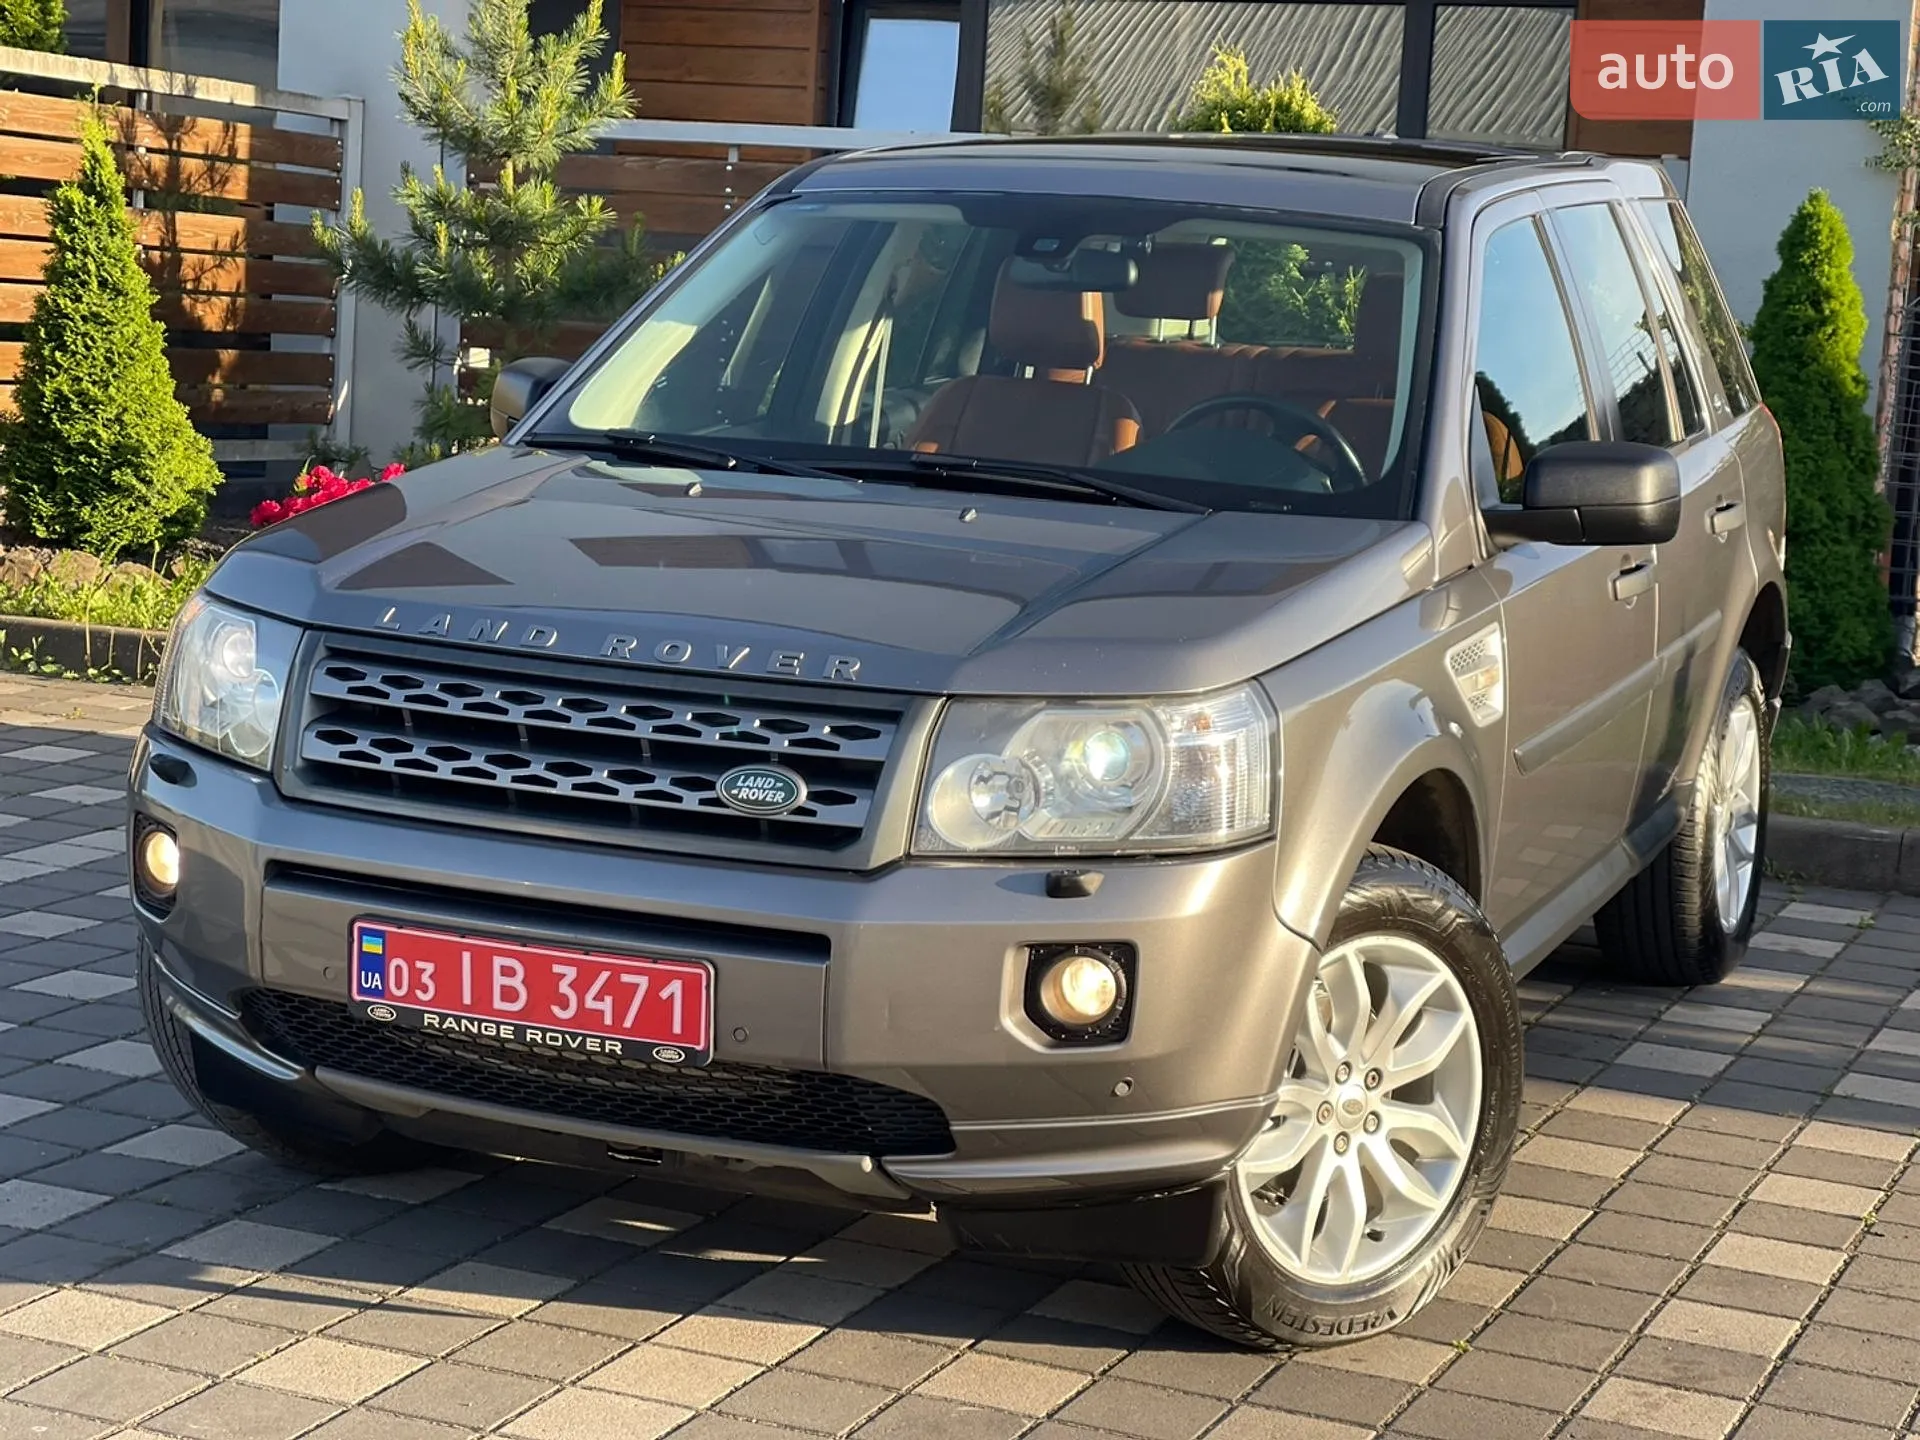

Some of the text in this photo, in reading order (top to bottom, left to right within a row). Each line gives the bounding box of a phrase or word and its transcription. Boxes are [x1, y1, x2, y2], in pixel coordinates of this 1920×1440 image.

[374, 606, 861, 681] LAND ROVER
[736, 775, 775, 789] LAND
[738, 787, 786, 803] ROVER
[361, 970, 383, 991] UA
[388, 957, 436, 1002] 03
[550, 963, 683, 1035] 3471
[423, 1012, 515, 1040] RANGE
[526, 1029, 623, 1056] ROVER
[1262, 1294, 1398, 1337] VREDESTEIN
